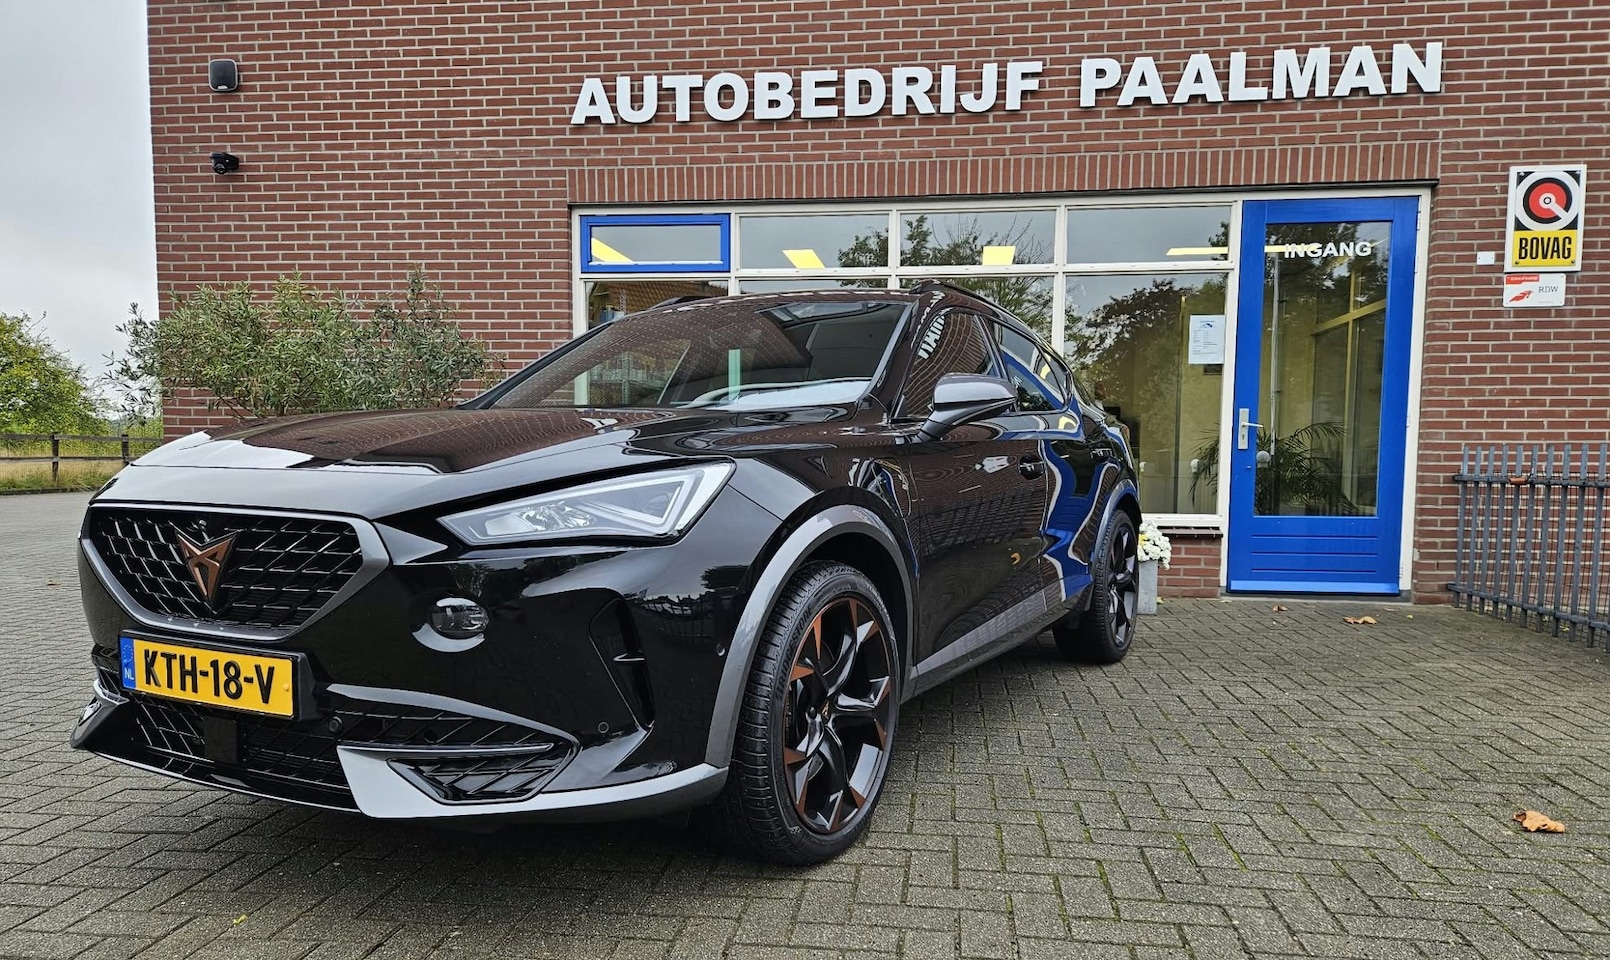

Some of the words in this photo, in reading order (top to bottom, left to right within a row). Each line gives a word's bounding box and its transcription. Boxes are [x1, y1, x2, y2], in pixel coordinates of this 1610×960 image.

[570, 61, 1043, 125] AUTOBEDRIJF
[1079, 42, 1443, 107] PAALMAN
[1284, 241, 1372, 258] INGANG
[1519, 236, 1572, 260] BOVAG
[124, 667, 135, 681] NL
[144, 649, 275, 704] KTH-18-V
